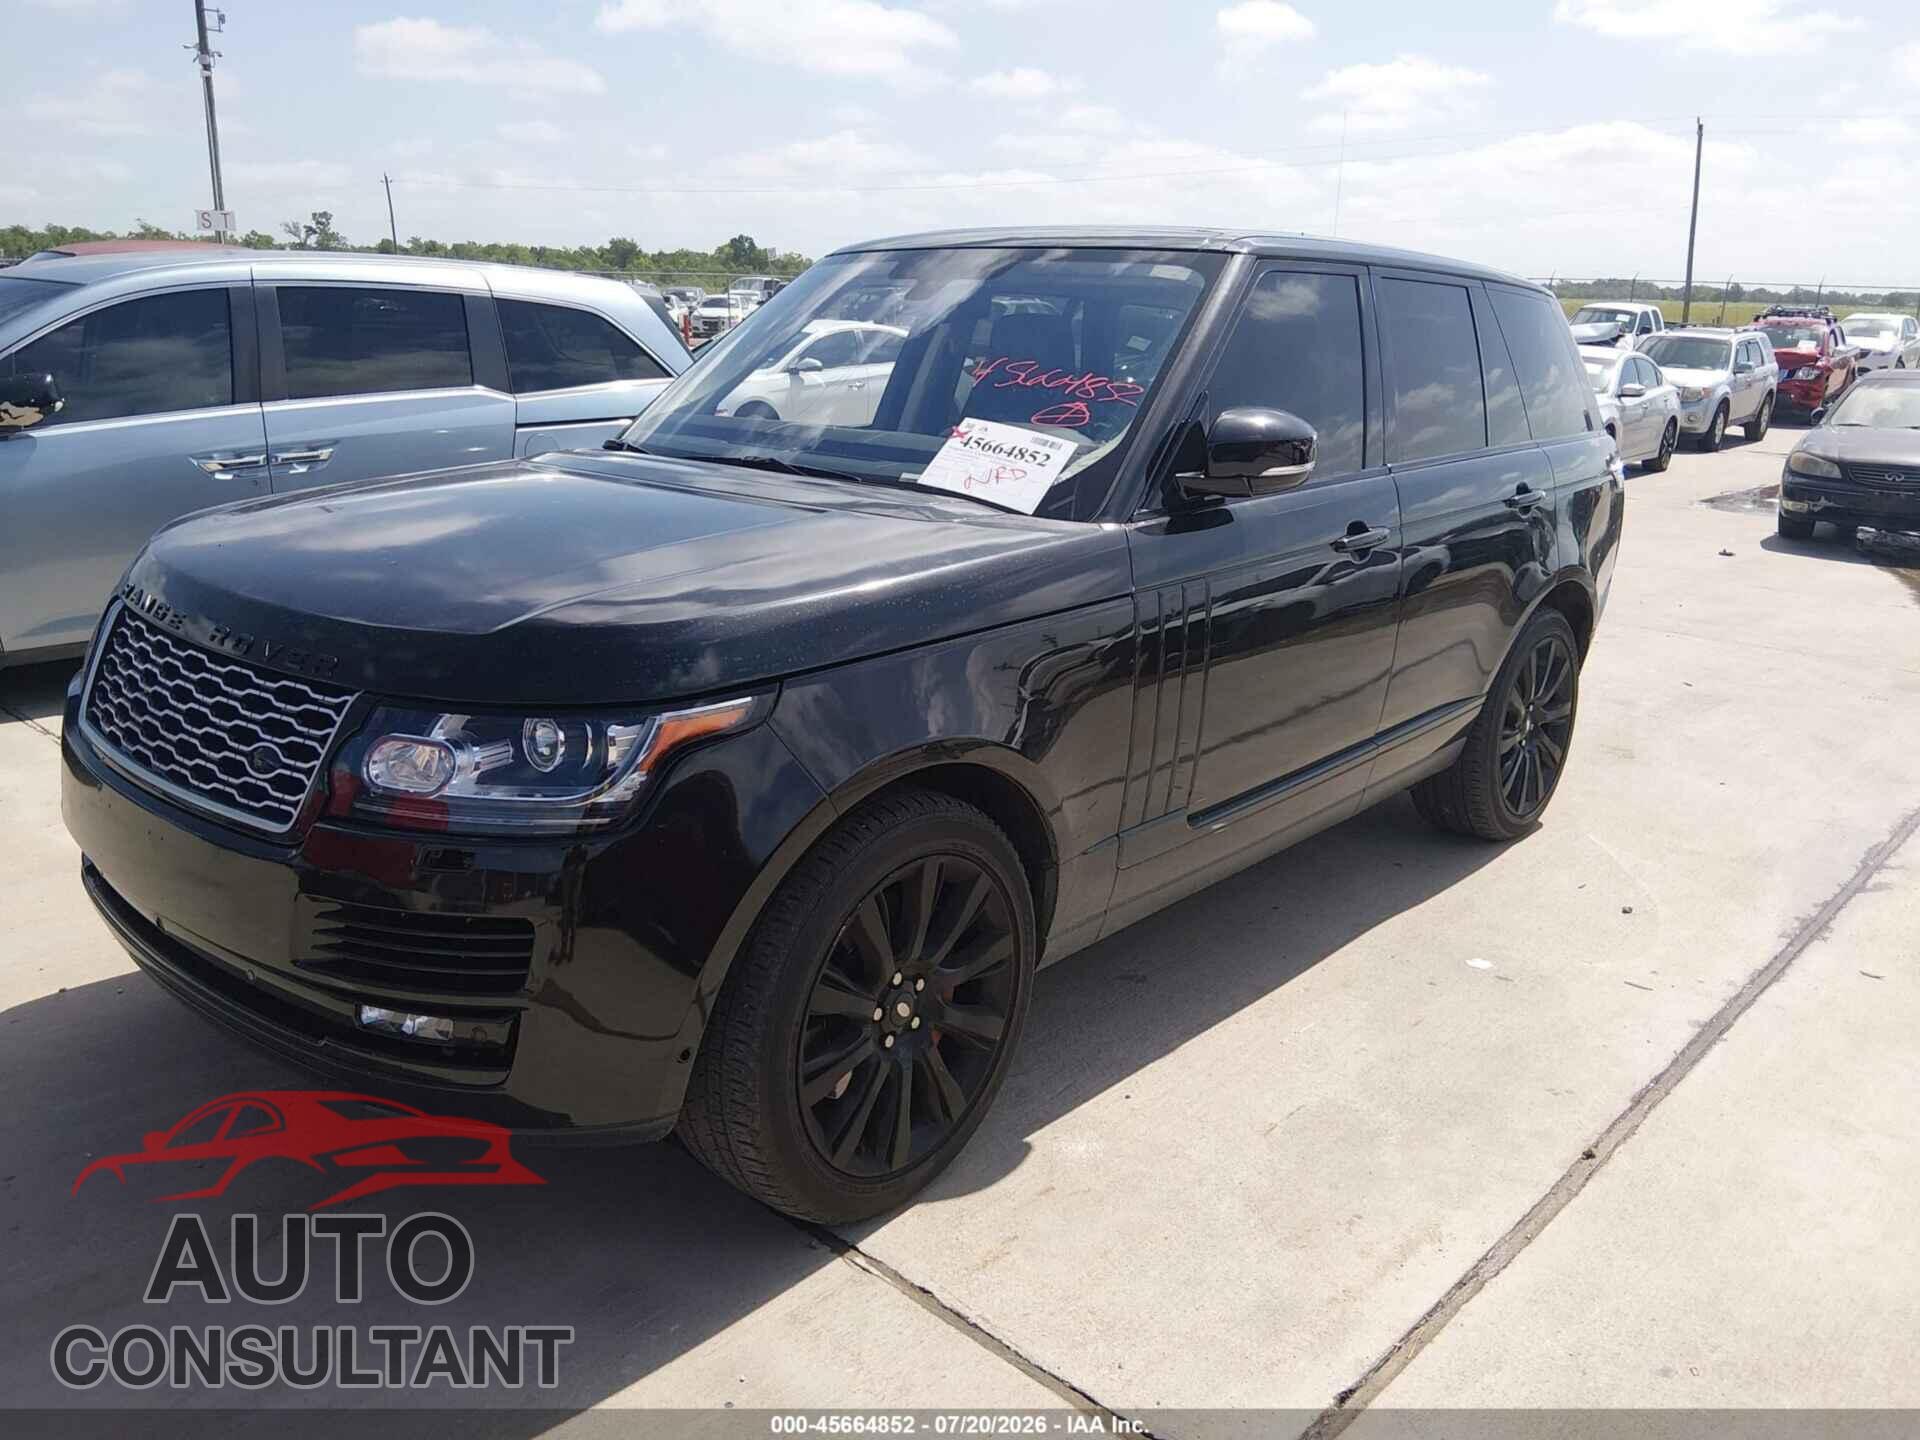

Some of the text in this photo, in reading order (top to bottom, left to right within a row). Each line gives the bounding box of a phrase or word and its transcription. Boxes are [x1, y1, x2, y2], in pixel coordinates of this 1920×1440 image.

[960, 435, 1051, 467] 45664852
[122, 583, 342, 678] RANGE ROVER
